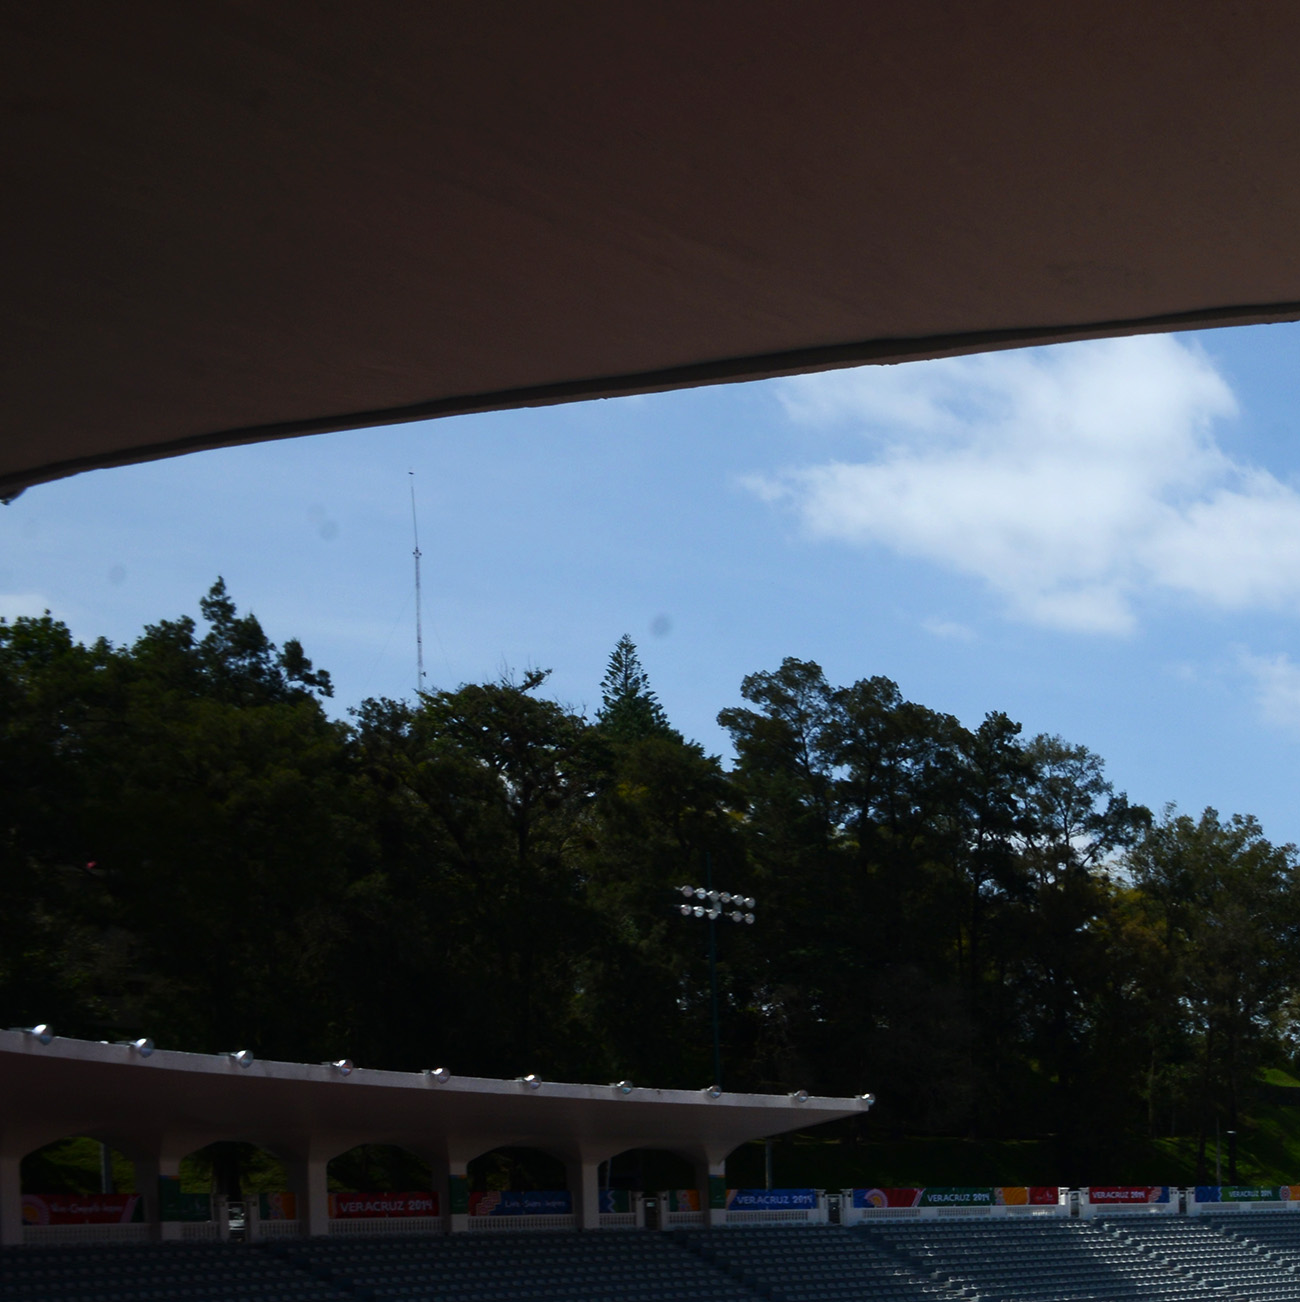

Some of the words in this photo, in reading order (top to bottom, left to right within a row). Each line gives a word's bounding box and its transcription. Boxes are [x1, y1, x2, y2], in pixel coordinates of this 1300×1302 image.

[928, 1193, 970, 1202] VERACRUZ
[973, 1192, 989, 1201] 2014
[1092, 1191, 1128, 1199] VERACRUZ
[1130, 1190, 1145, 1198] 2014
[738, 1196, 788, 1204] VERACRUZ
[792, 1195, 812, 1204] 2014
[340, 1202, 406, 1212] VERACRUZ
[408, 1200, 432, 1211] 2014
